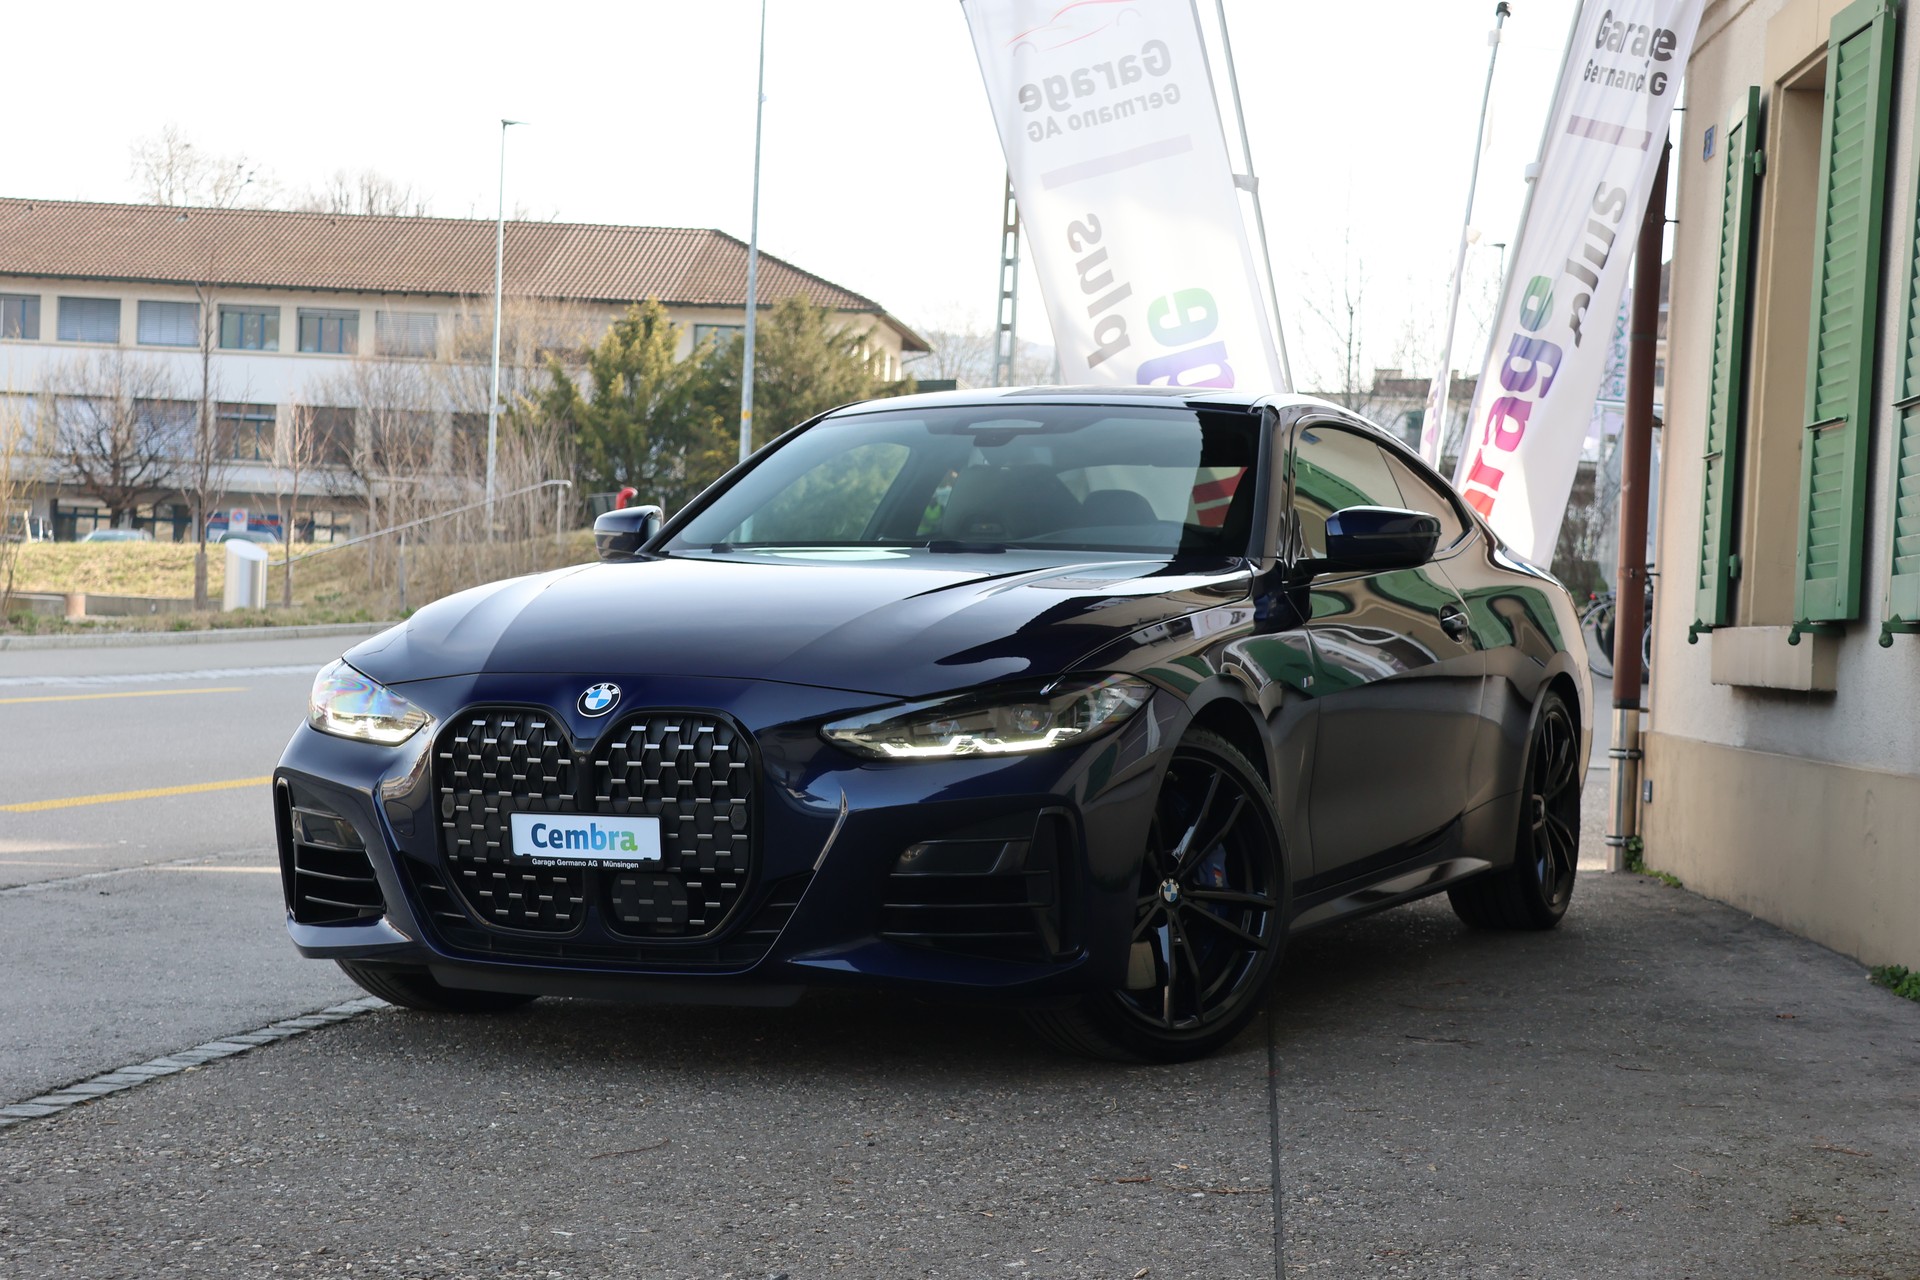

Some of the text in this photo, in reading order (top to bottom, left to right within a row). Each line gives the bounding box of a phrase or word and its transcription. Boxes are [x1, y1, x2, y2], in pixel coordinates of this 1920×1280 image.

[531, 822, 638, 852] Cembra
[532, 858, 555, 867] Garage
[557, 859, 586, 867] Germano
[603, 860, 639, 870] Münsingen
